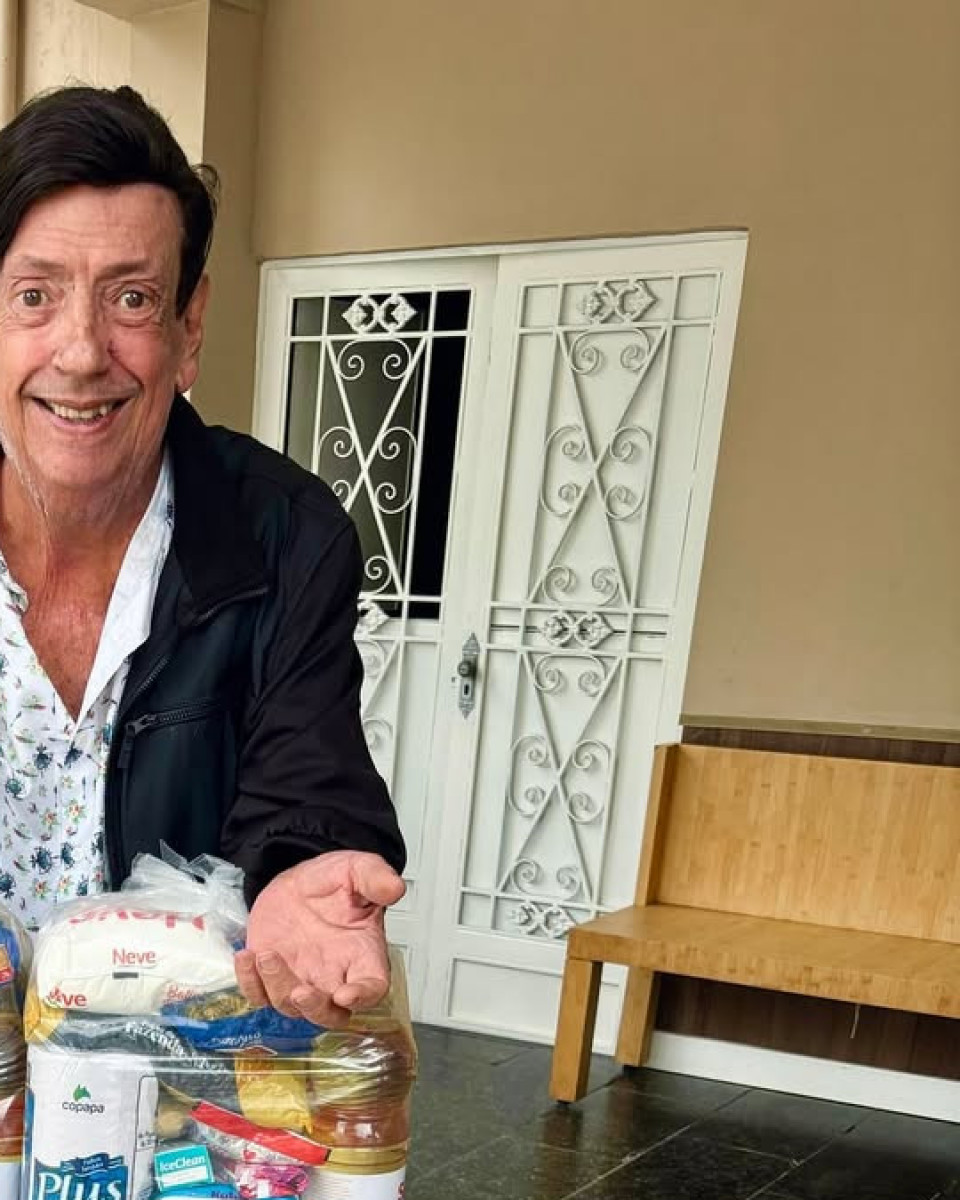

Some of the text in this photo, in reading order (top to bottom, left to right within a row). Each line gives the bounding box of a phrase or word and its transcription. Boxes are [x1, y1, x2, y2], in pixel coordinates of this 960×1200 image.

[112, 948, 157, 965] Neve
[61, 1100, 105, 1115] copapa
[158, 1154, 208, 1174] IceClean
